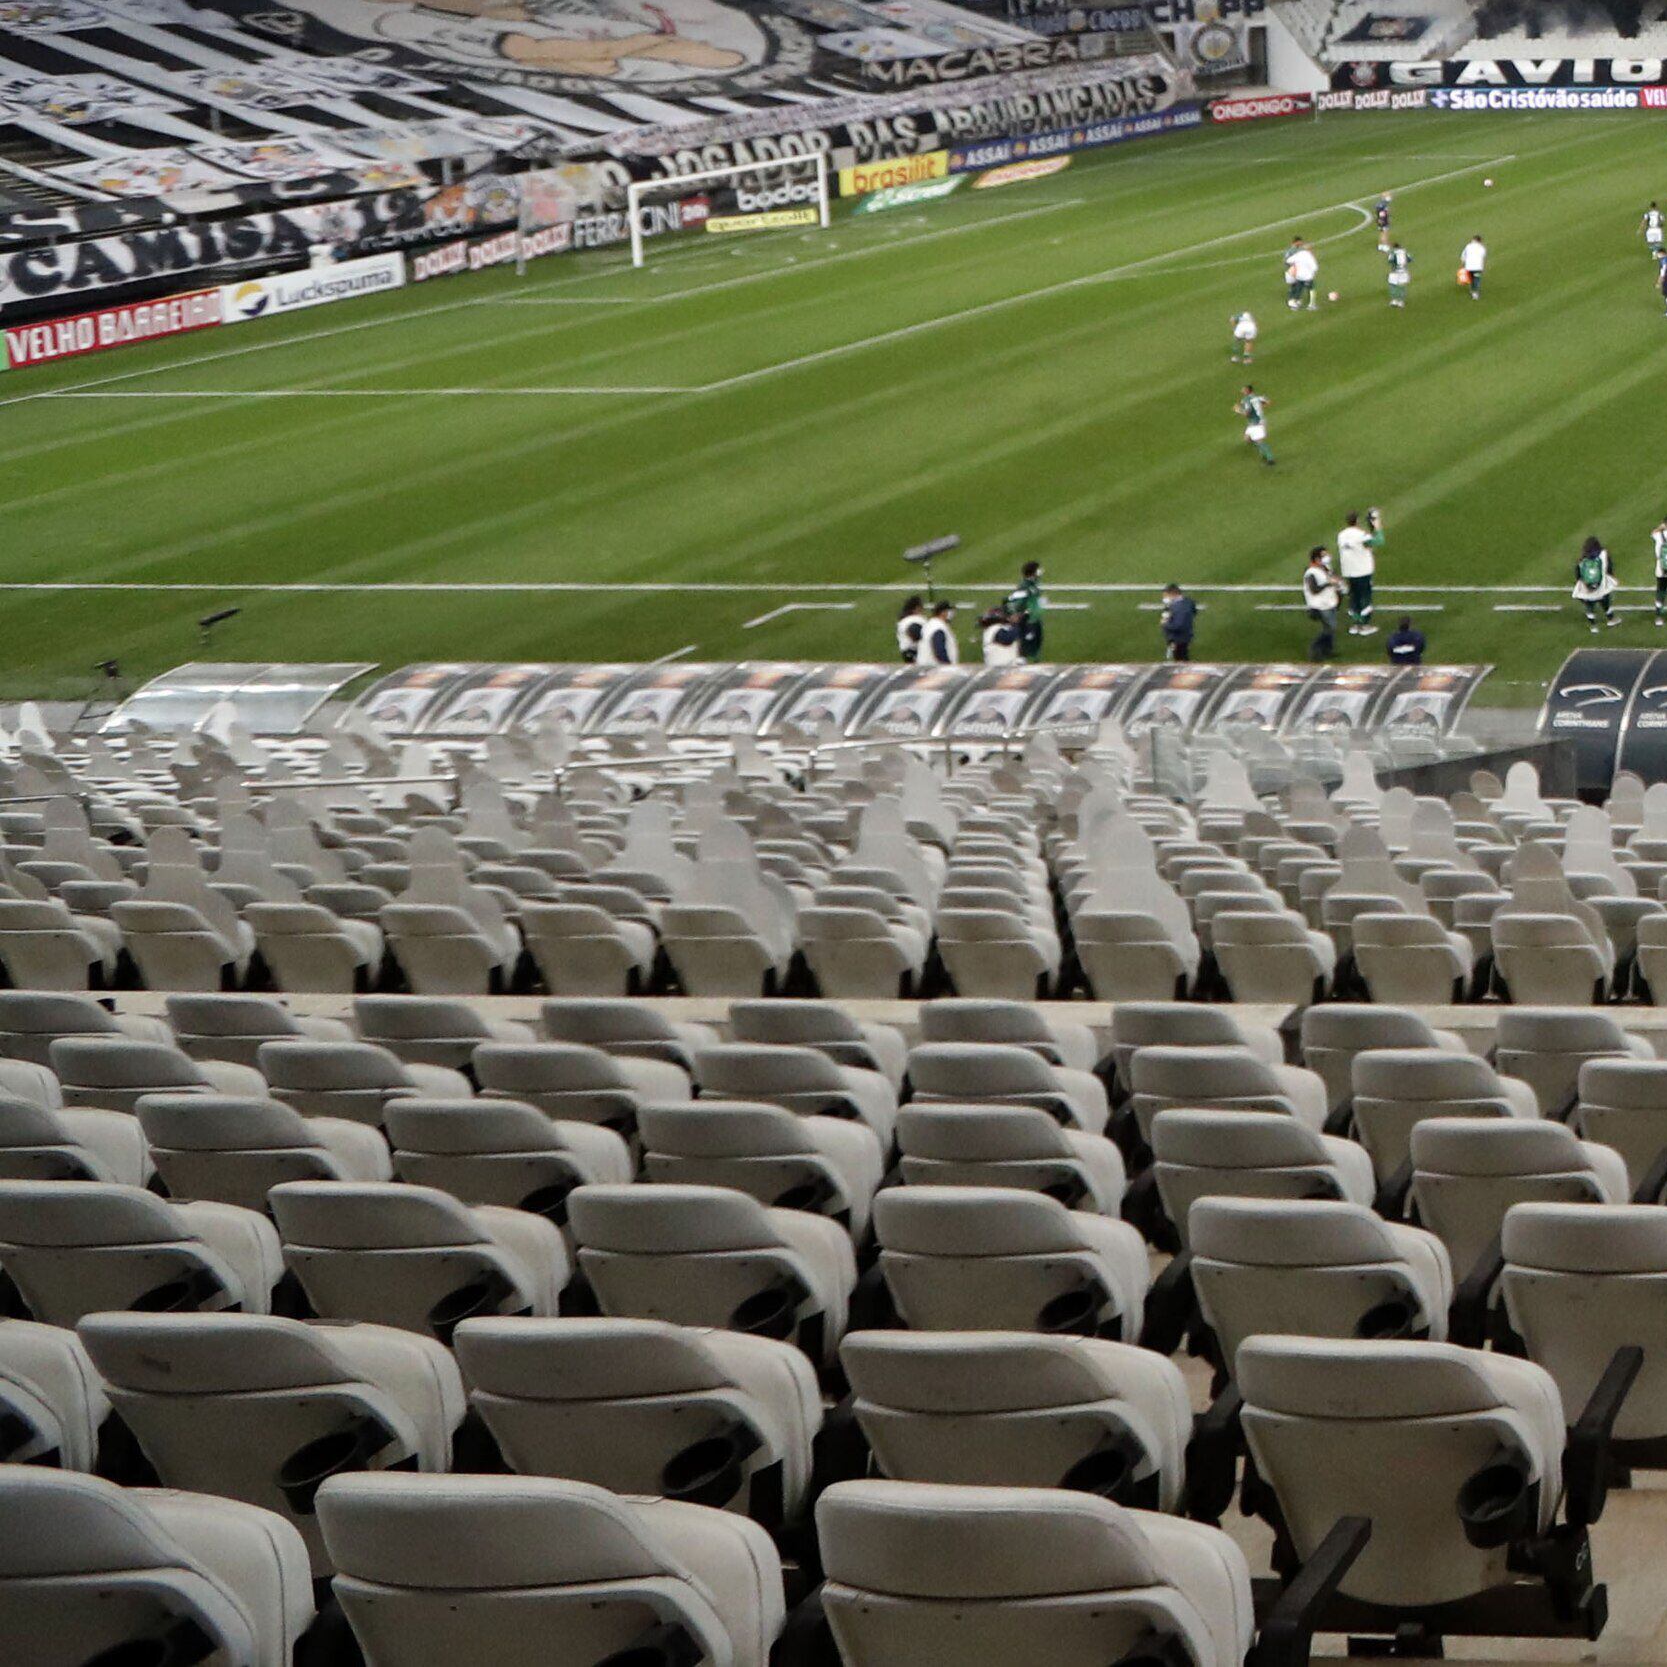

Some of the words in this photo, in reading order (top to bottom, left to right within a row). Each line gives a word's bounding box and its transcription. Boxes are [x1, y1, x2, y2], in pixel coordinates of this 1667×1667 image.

[865, 37, 1080, 84] MACABRA
[1212, 98, 1294, 120] ONBONGO
[1317, 91, 1353, 110] DOLLY
[1354, 91, 1389, 110] DOLLY
[1390, 90, 1426, 109] DOLLY
[1449, 90, 1488, 109] São
[1488, 89, 1580, 108] Cristóvão
[1580, 89, 1639, 108] saúde
[853, 151, 938, 193] brasilit
[736, 180, 820, 212] bodog
[8, 212, 310, 297] CAMISA
[8, 316, 96, 364] VELHO
[99, 291, 222, 347] BARREIRO
